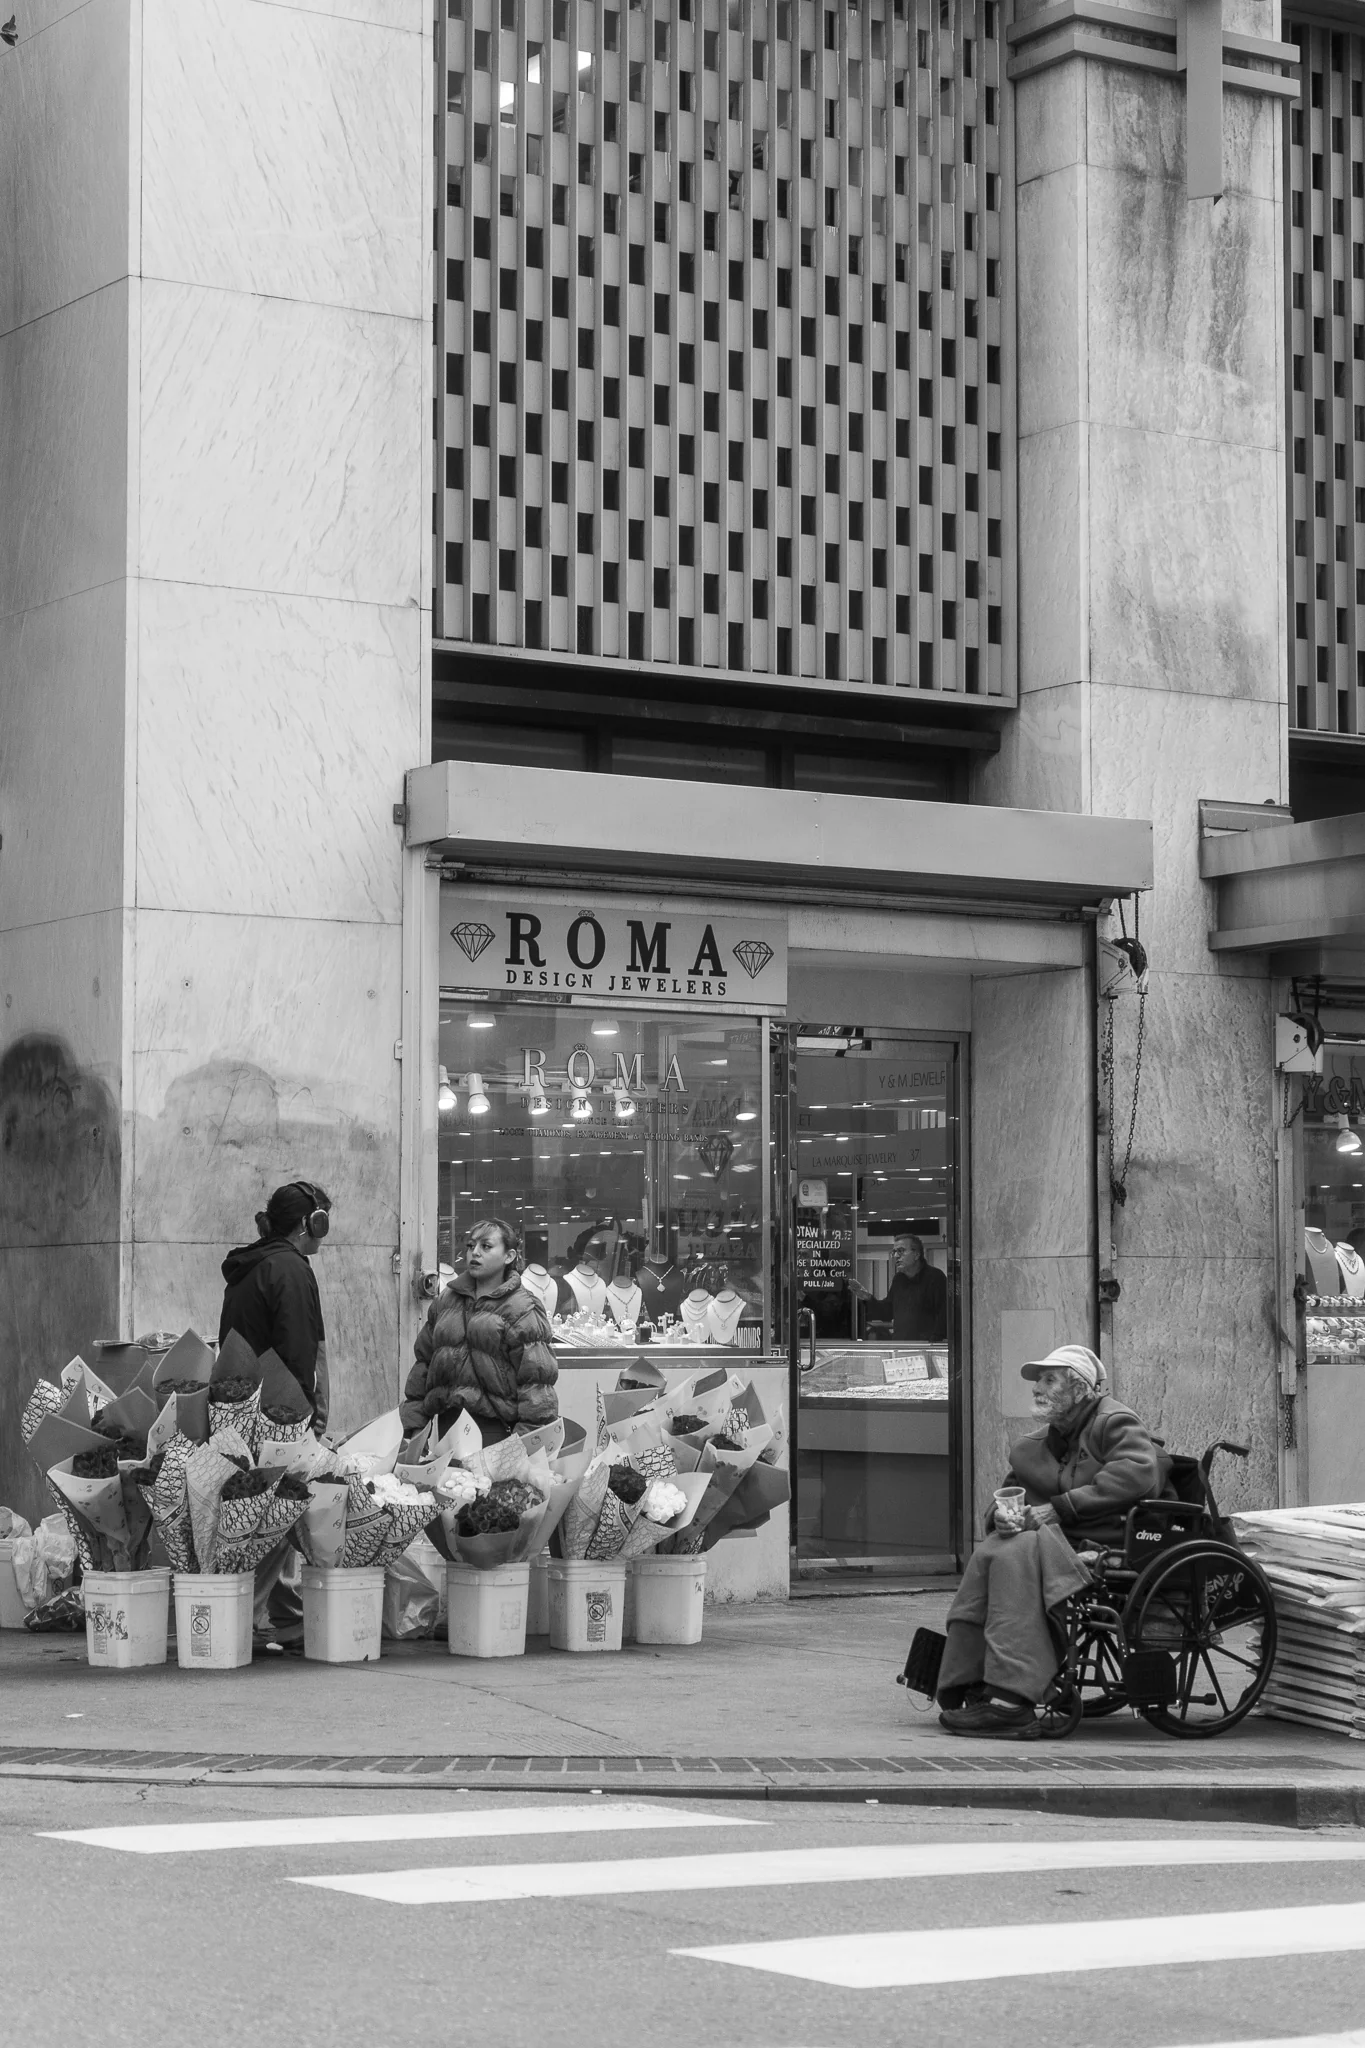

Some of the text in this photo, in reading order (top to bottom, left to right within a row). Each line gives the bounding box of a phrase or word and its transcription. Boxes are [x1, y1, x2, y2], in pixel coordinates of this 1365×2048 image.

[505, 910, 728, 978] ROMA
[506, 969, 726, 996] DESIGN JEWELERS
[521, 1043, 688, 1092] ROMA
[521, 1097, 690, 1114] DESIGN JEWELERS
[643, 1132, 681, 1142] WEDDING
[684, 1134, 709, 1143] BANDS
[797, 1240, 841, 1249] PECIALIZED
[812, 1250, 821, 1258] IN
[810, 1259, 851, 1268] DIAMONDS
[803, 1269, 810, 1277] &
[813, 1269, 827, 1277] GIA
[1135, 1529, 1162, 1542] drive
